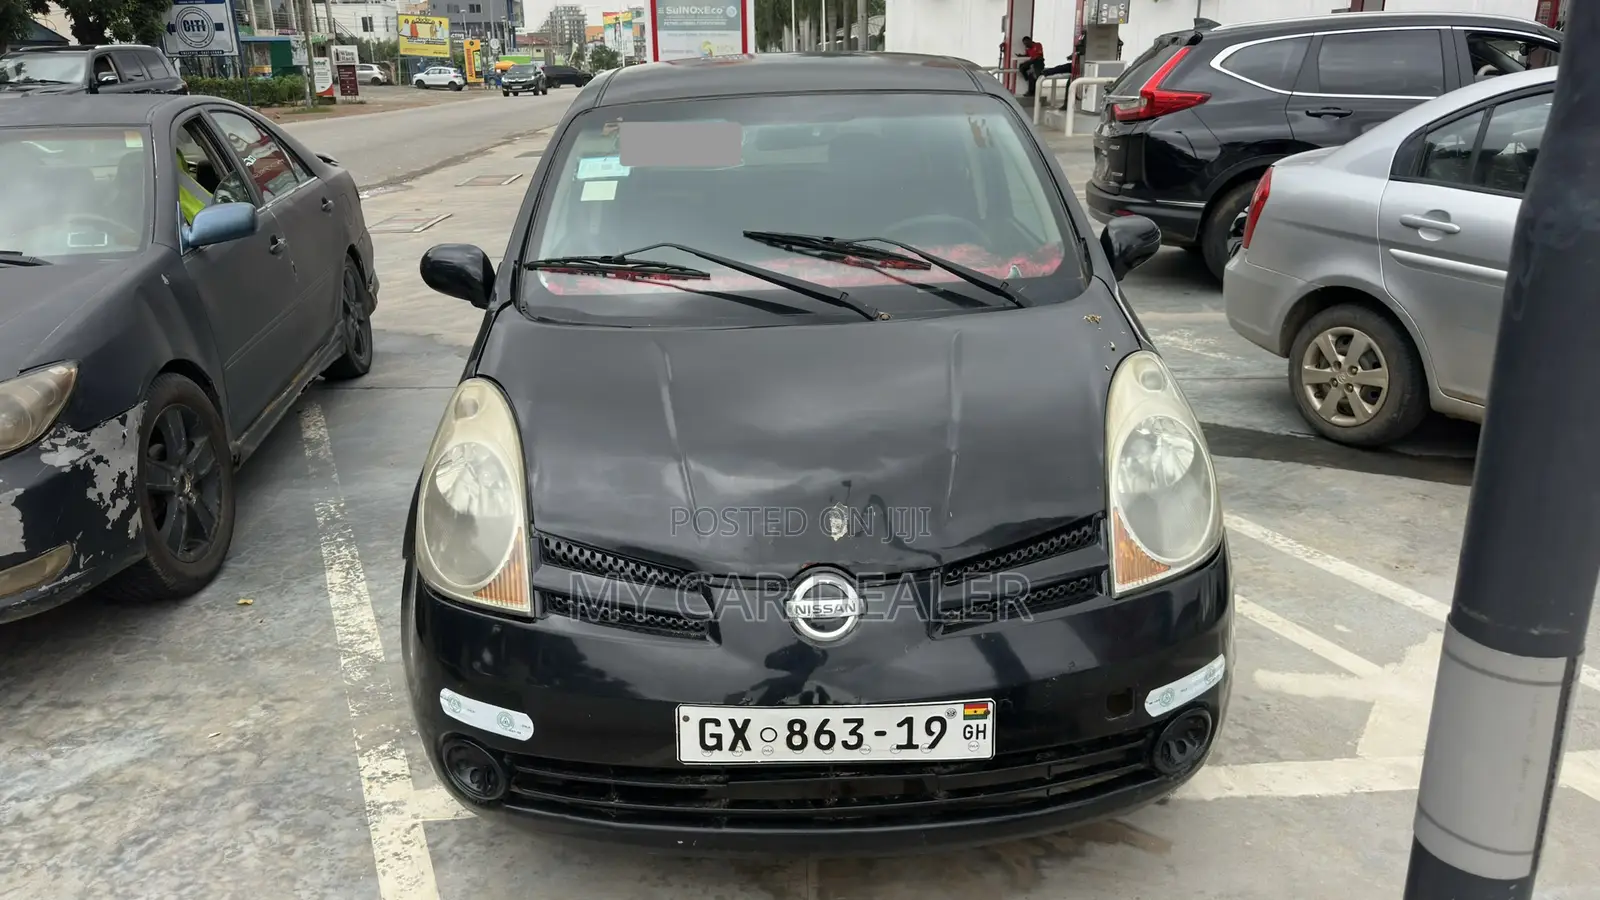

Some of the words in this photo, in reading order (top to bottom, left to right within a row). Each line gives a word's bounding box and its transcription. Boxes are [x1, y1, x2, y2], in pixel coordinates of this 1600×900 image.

[182, 19, 206, 32] CITI
[795, 603, 856, 615] NISSAN
[698, 717, 752, 751] GX
[785, 716, 948, 751] 863-19
[962, 723, 987, 741] GH
